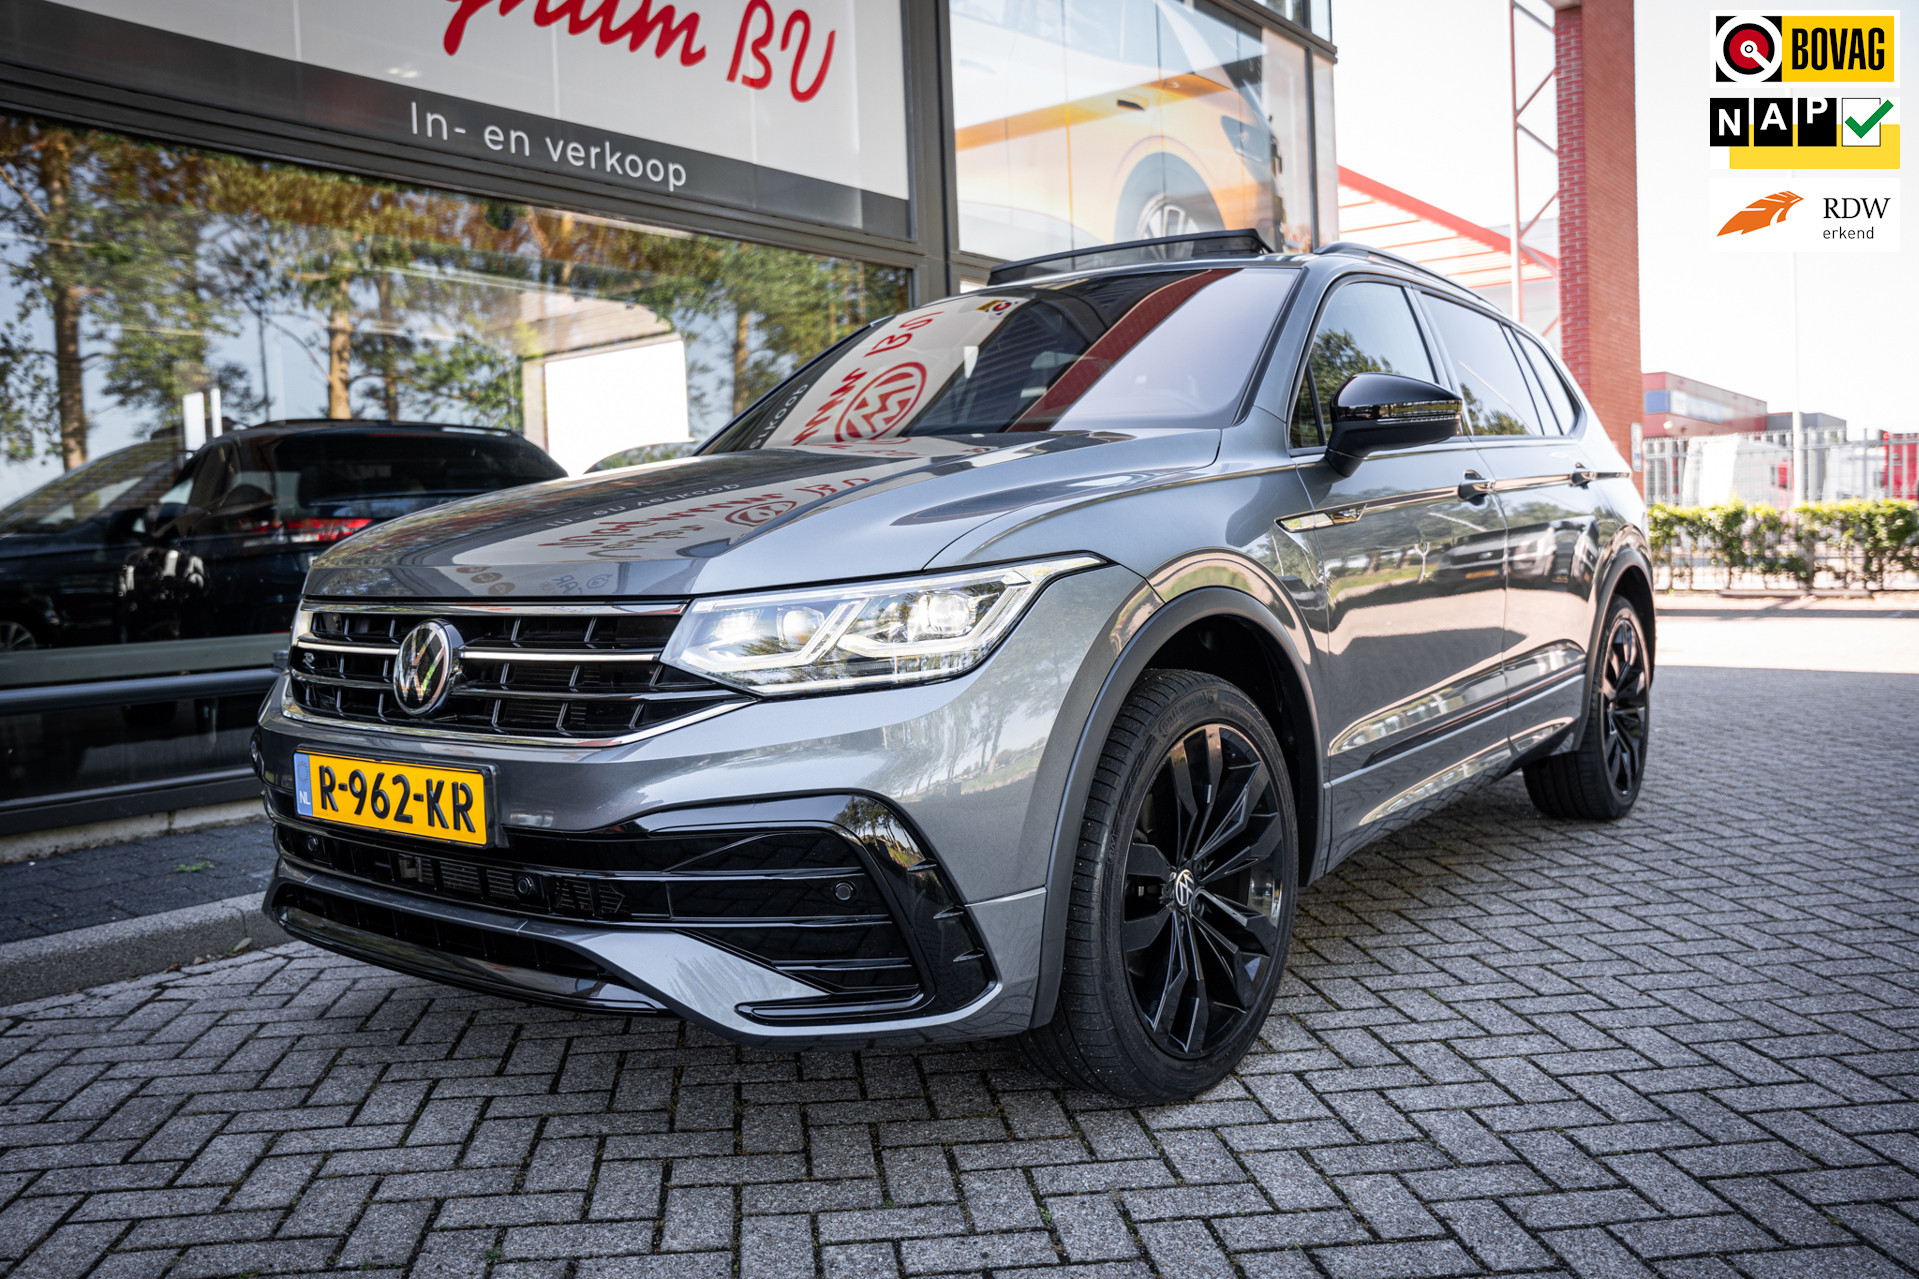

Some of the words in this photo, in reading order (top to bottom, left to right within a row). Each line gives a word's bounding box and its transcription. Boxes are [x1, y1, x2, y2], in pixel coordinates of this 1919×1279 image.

[726, 0, 836, 103] BV
[409, 102, 467, 140] In-
[484, 125, 530, 157] en
[545, 136, 687, 191] verkoop
[299, 790, 311, 806] NL
[318, 764, 477, 833] R-962-KR
